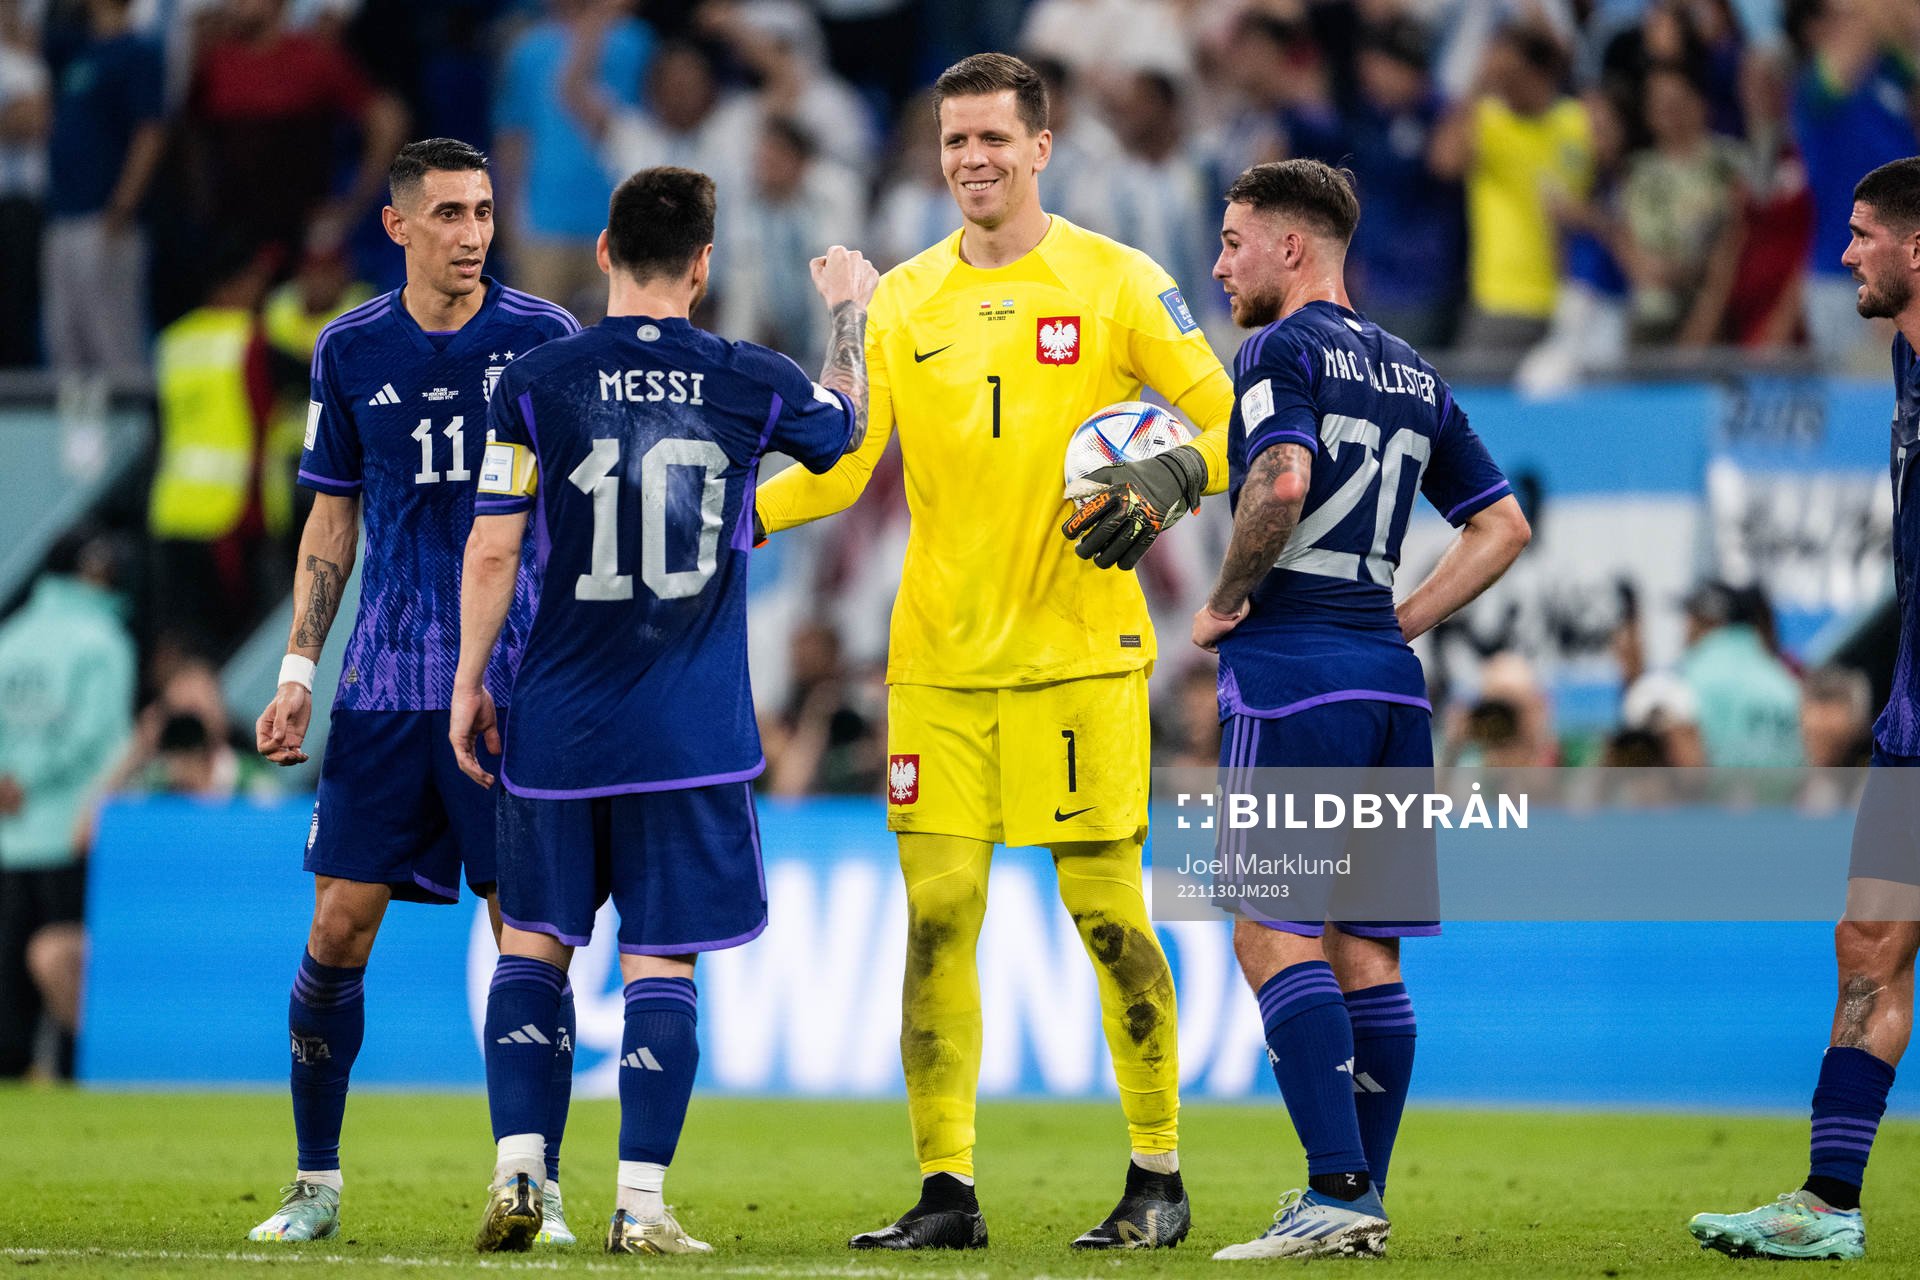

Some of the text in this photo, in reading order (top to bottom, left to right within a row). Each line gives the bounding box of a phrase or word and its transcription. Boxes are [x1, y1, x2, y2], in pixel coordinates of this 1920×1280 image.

[598, 369, 704, 405] MESSI
[1322, 346, 1364, 382] MAC
[987, 376, 1000, 438] 1
[410, 415, 471, 484] 11
[567, 438, 731, 600] 10
[1067, 491, 1111, 534] reusch
[1273, 413, 1431, 587] 20
[1061, 730, 1077, 793] 1
